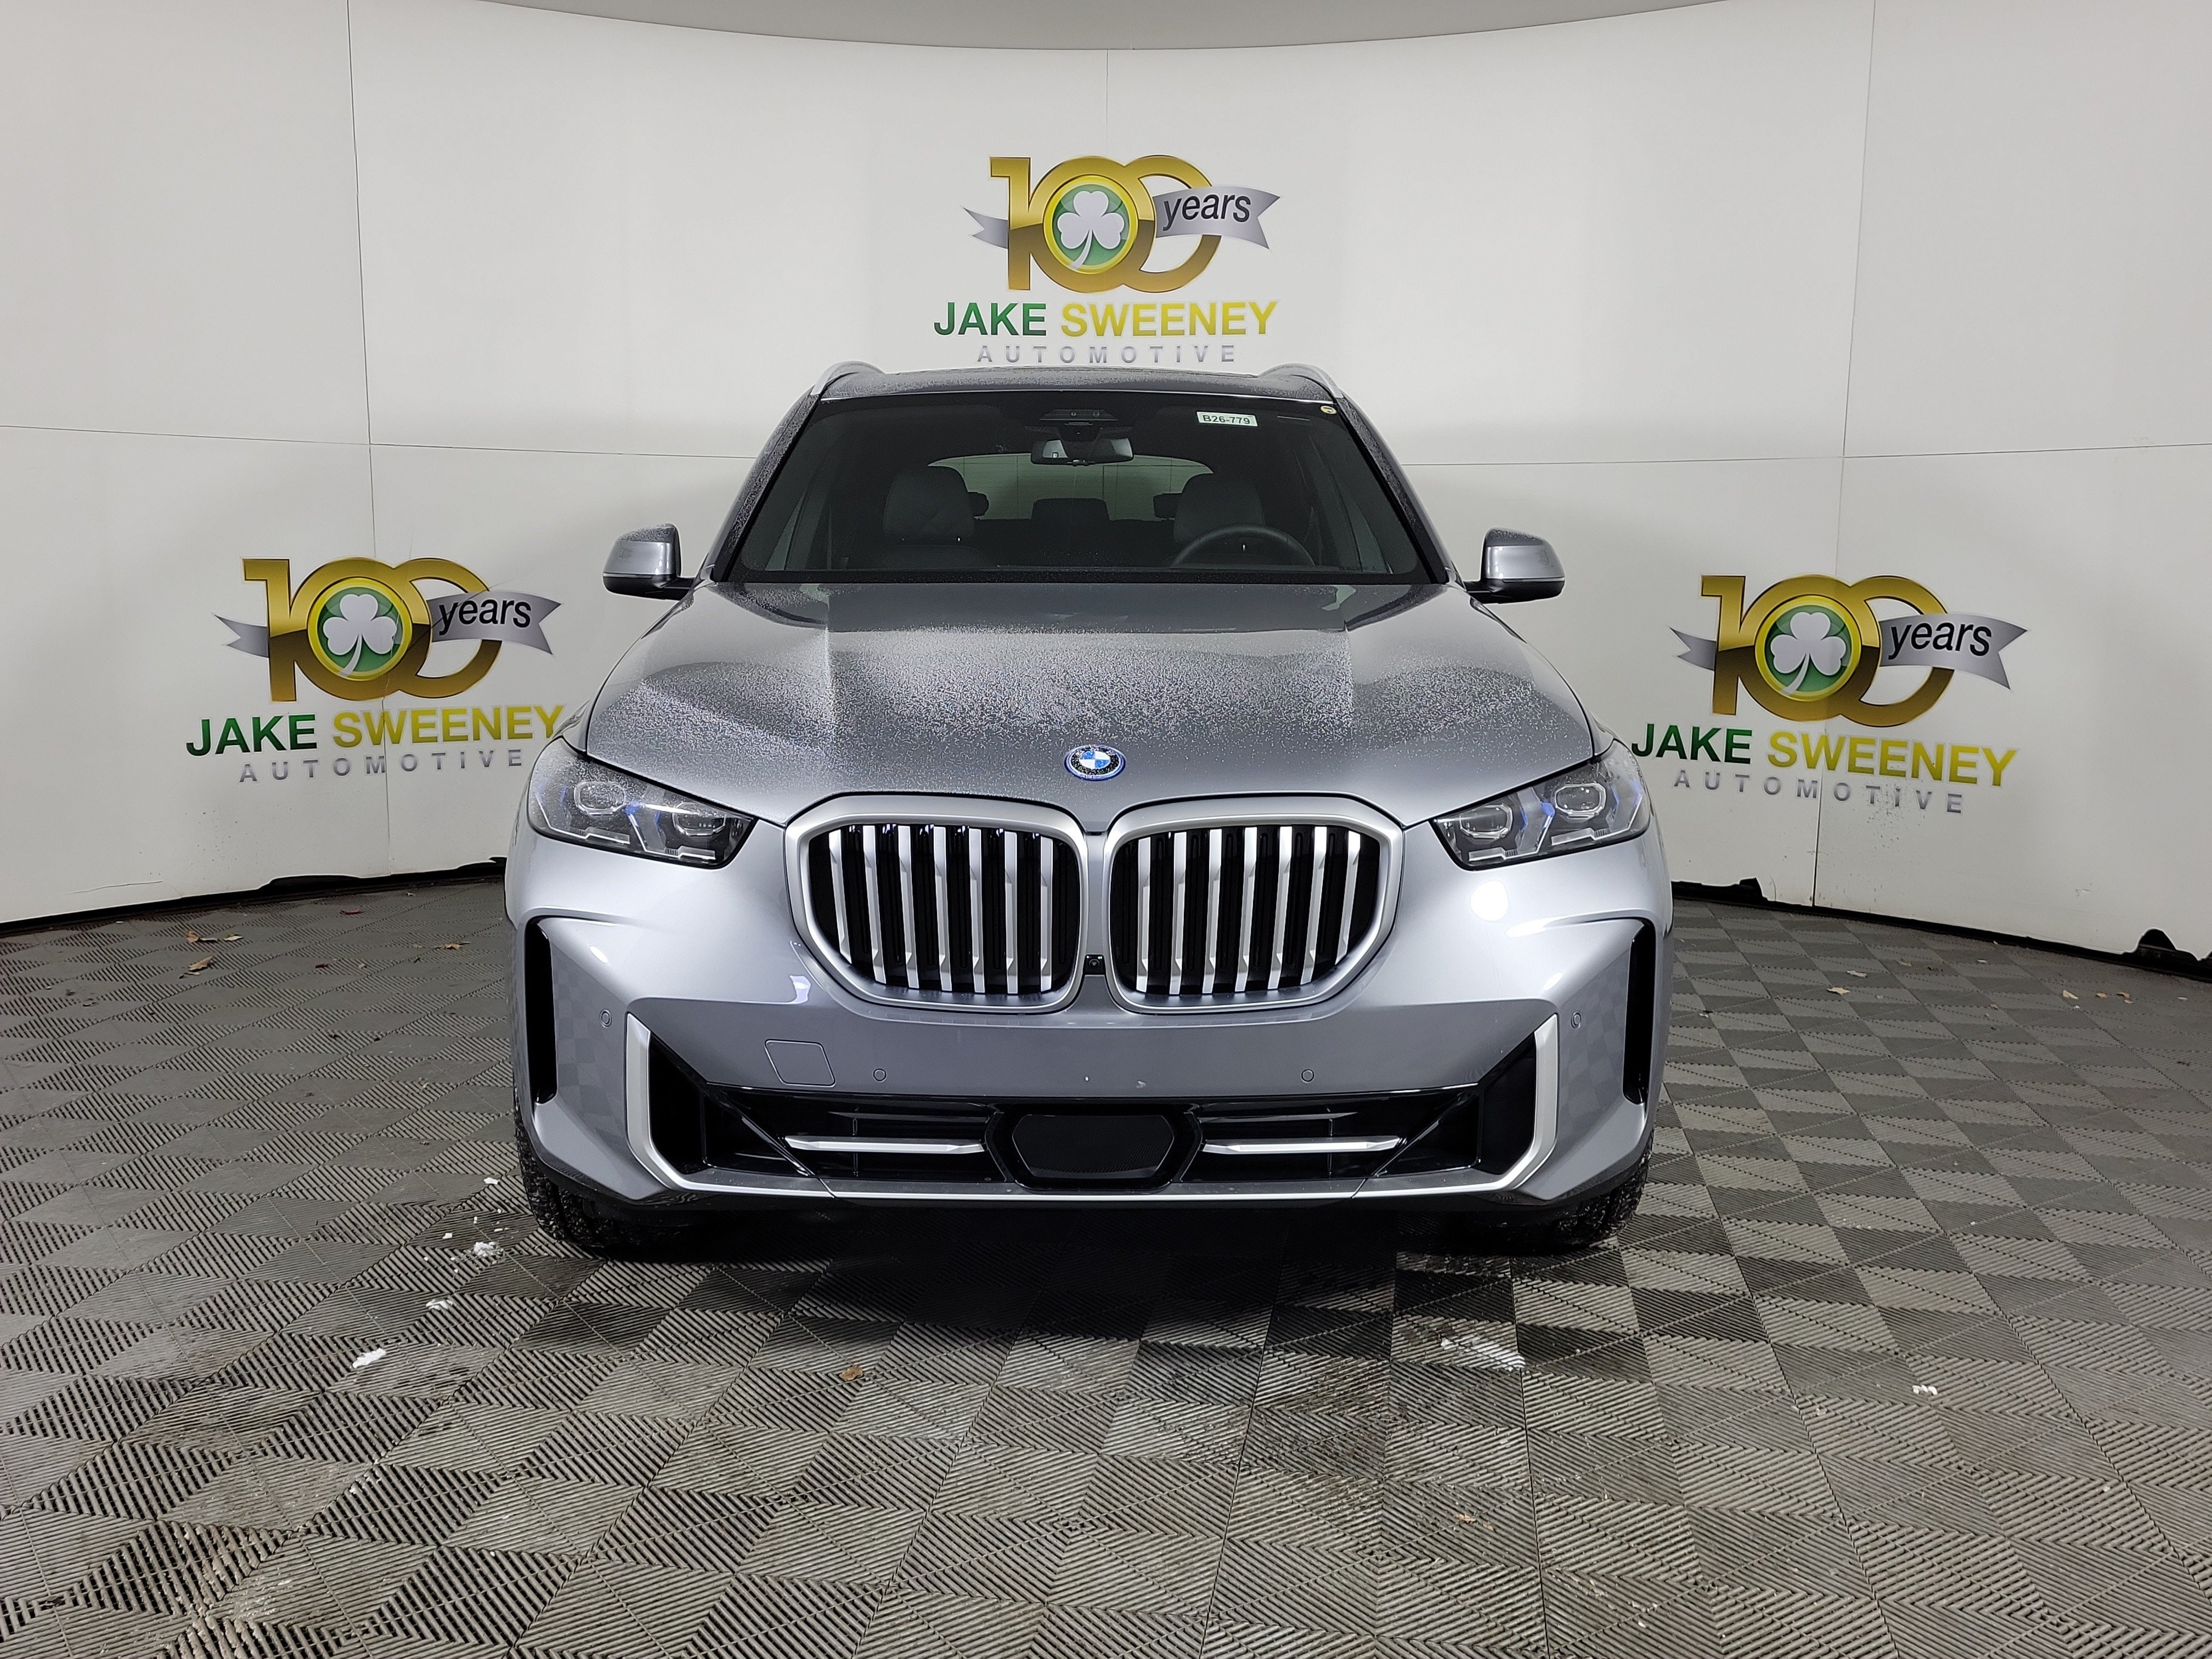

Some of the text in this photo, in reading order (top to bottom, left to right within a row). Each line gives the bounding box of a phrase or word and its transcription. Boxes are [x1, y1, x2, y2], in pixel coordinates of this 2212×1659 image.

[1163, 194, 1252, 231] years
[934, 302, 1277, 336] JAKE SWEENEY
[977, 345, 1235, 364] AUTOMOTIVE
[1203, 415, 1250, 424] B26-779
[439, 599, 532, 636] years
[1888, 622, 1992, 659] years
[186, 706, 564, 756] JAKE SWEENEY
[239, 749, 523, 783] AUTOMOTIVE
[1631, 723, 2017, 787] JAKE SWEENEY
[1674, 770, 1962, 814] AUTOMOTIVE
